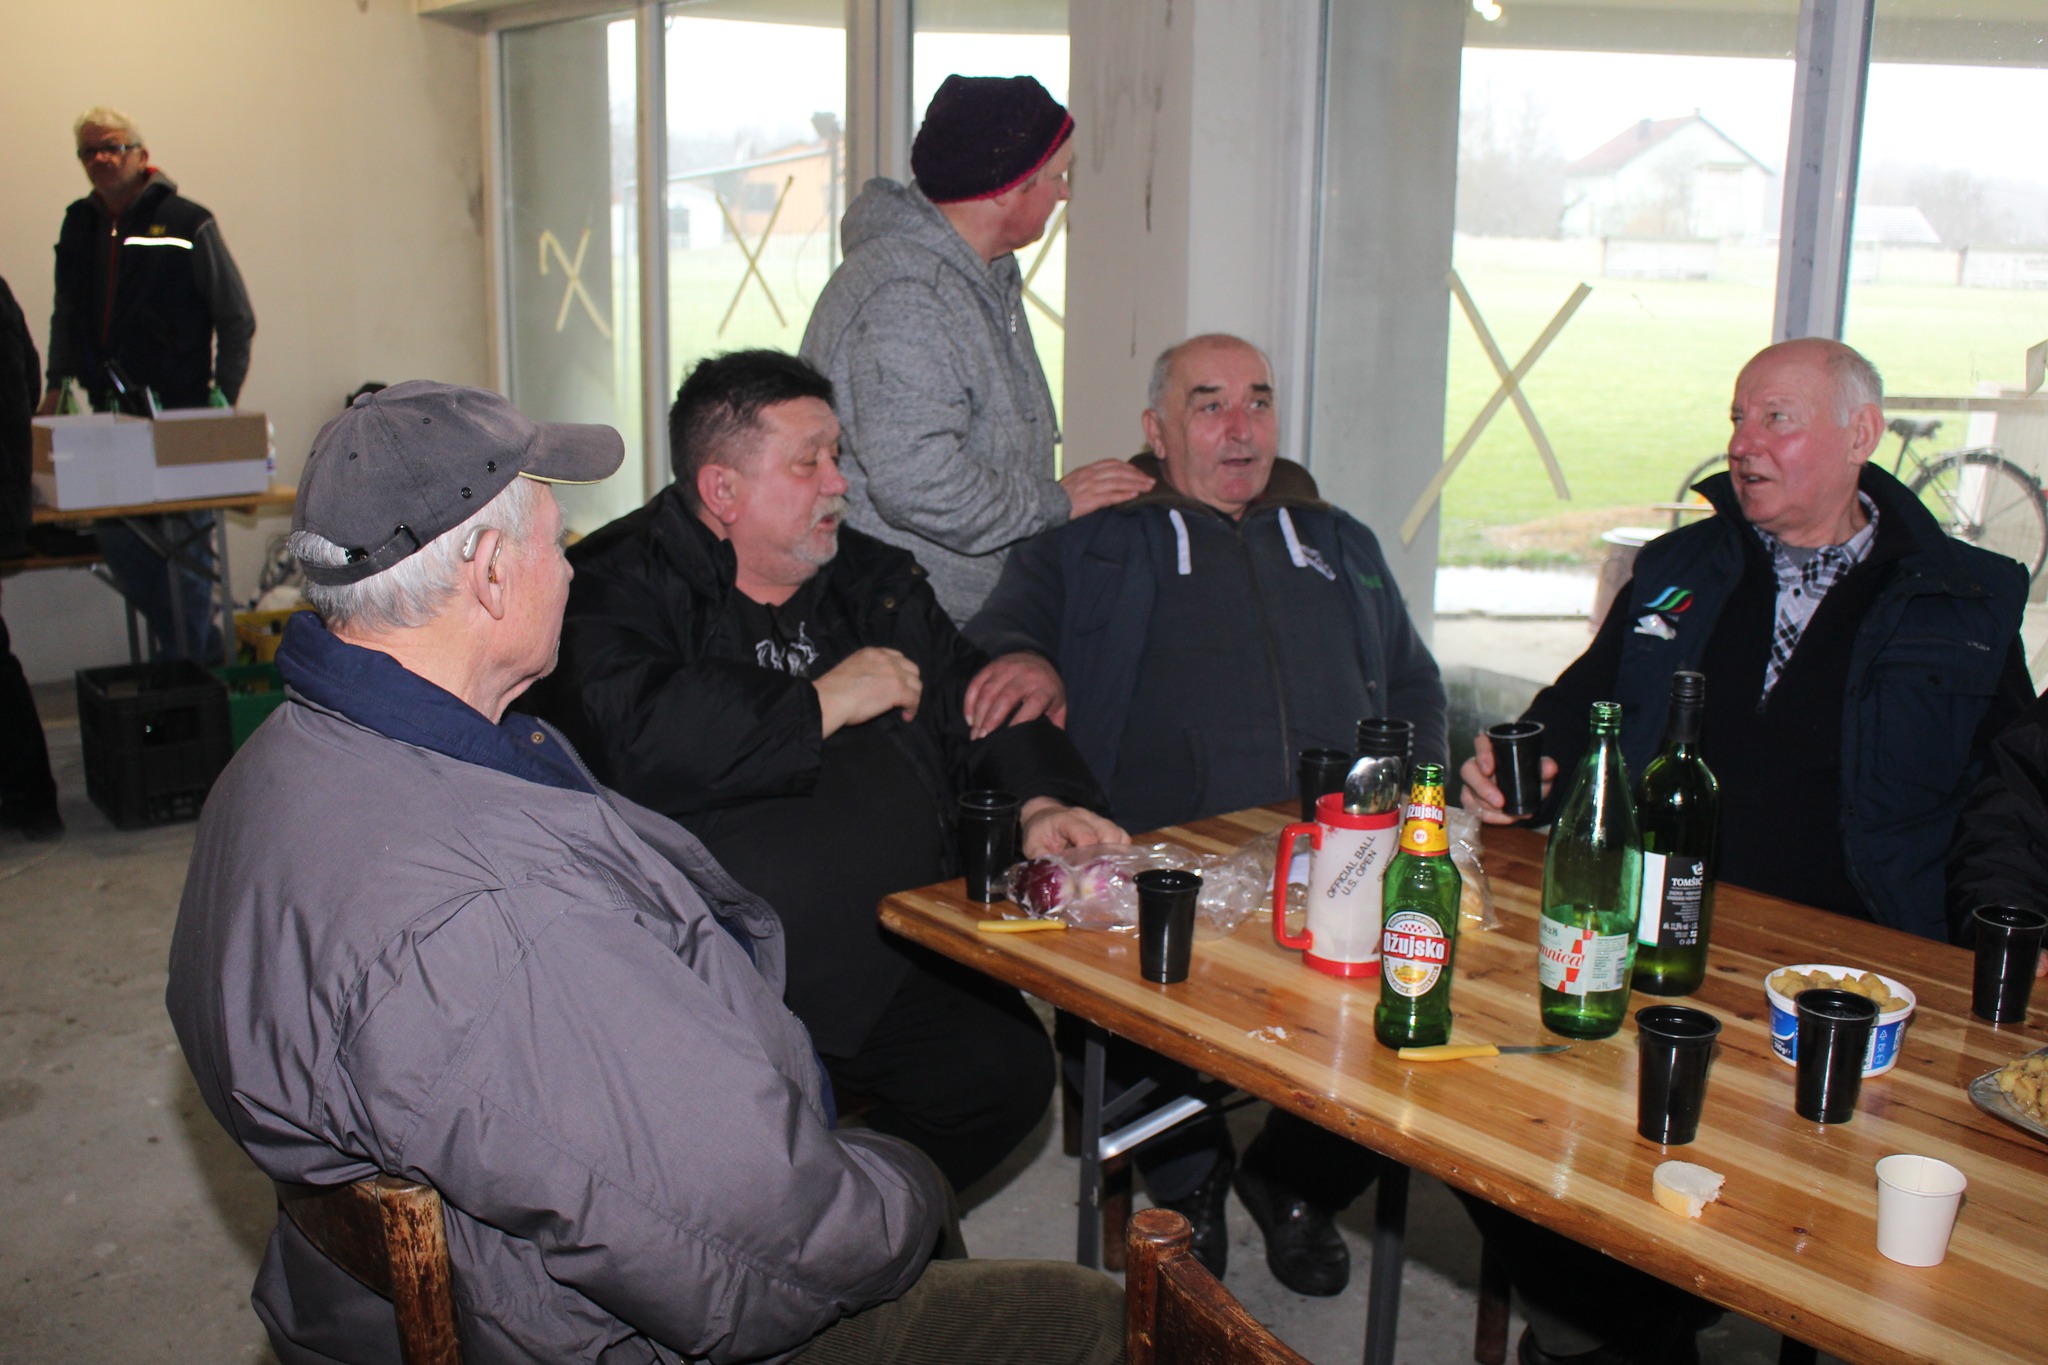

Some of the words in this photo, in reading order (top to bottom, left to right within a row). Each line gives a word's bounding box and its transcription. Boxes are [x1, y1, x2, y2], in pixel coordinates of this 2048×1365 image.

[1327, 861, 1358, 899] OFFICIAL
[1354, 835, 1376, 860] BALL
[1355, 849, 1377, 877] OPEN
[1383, 931, 1446, 960] Ožujsko
